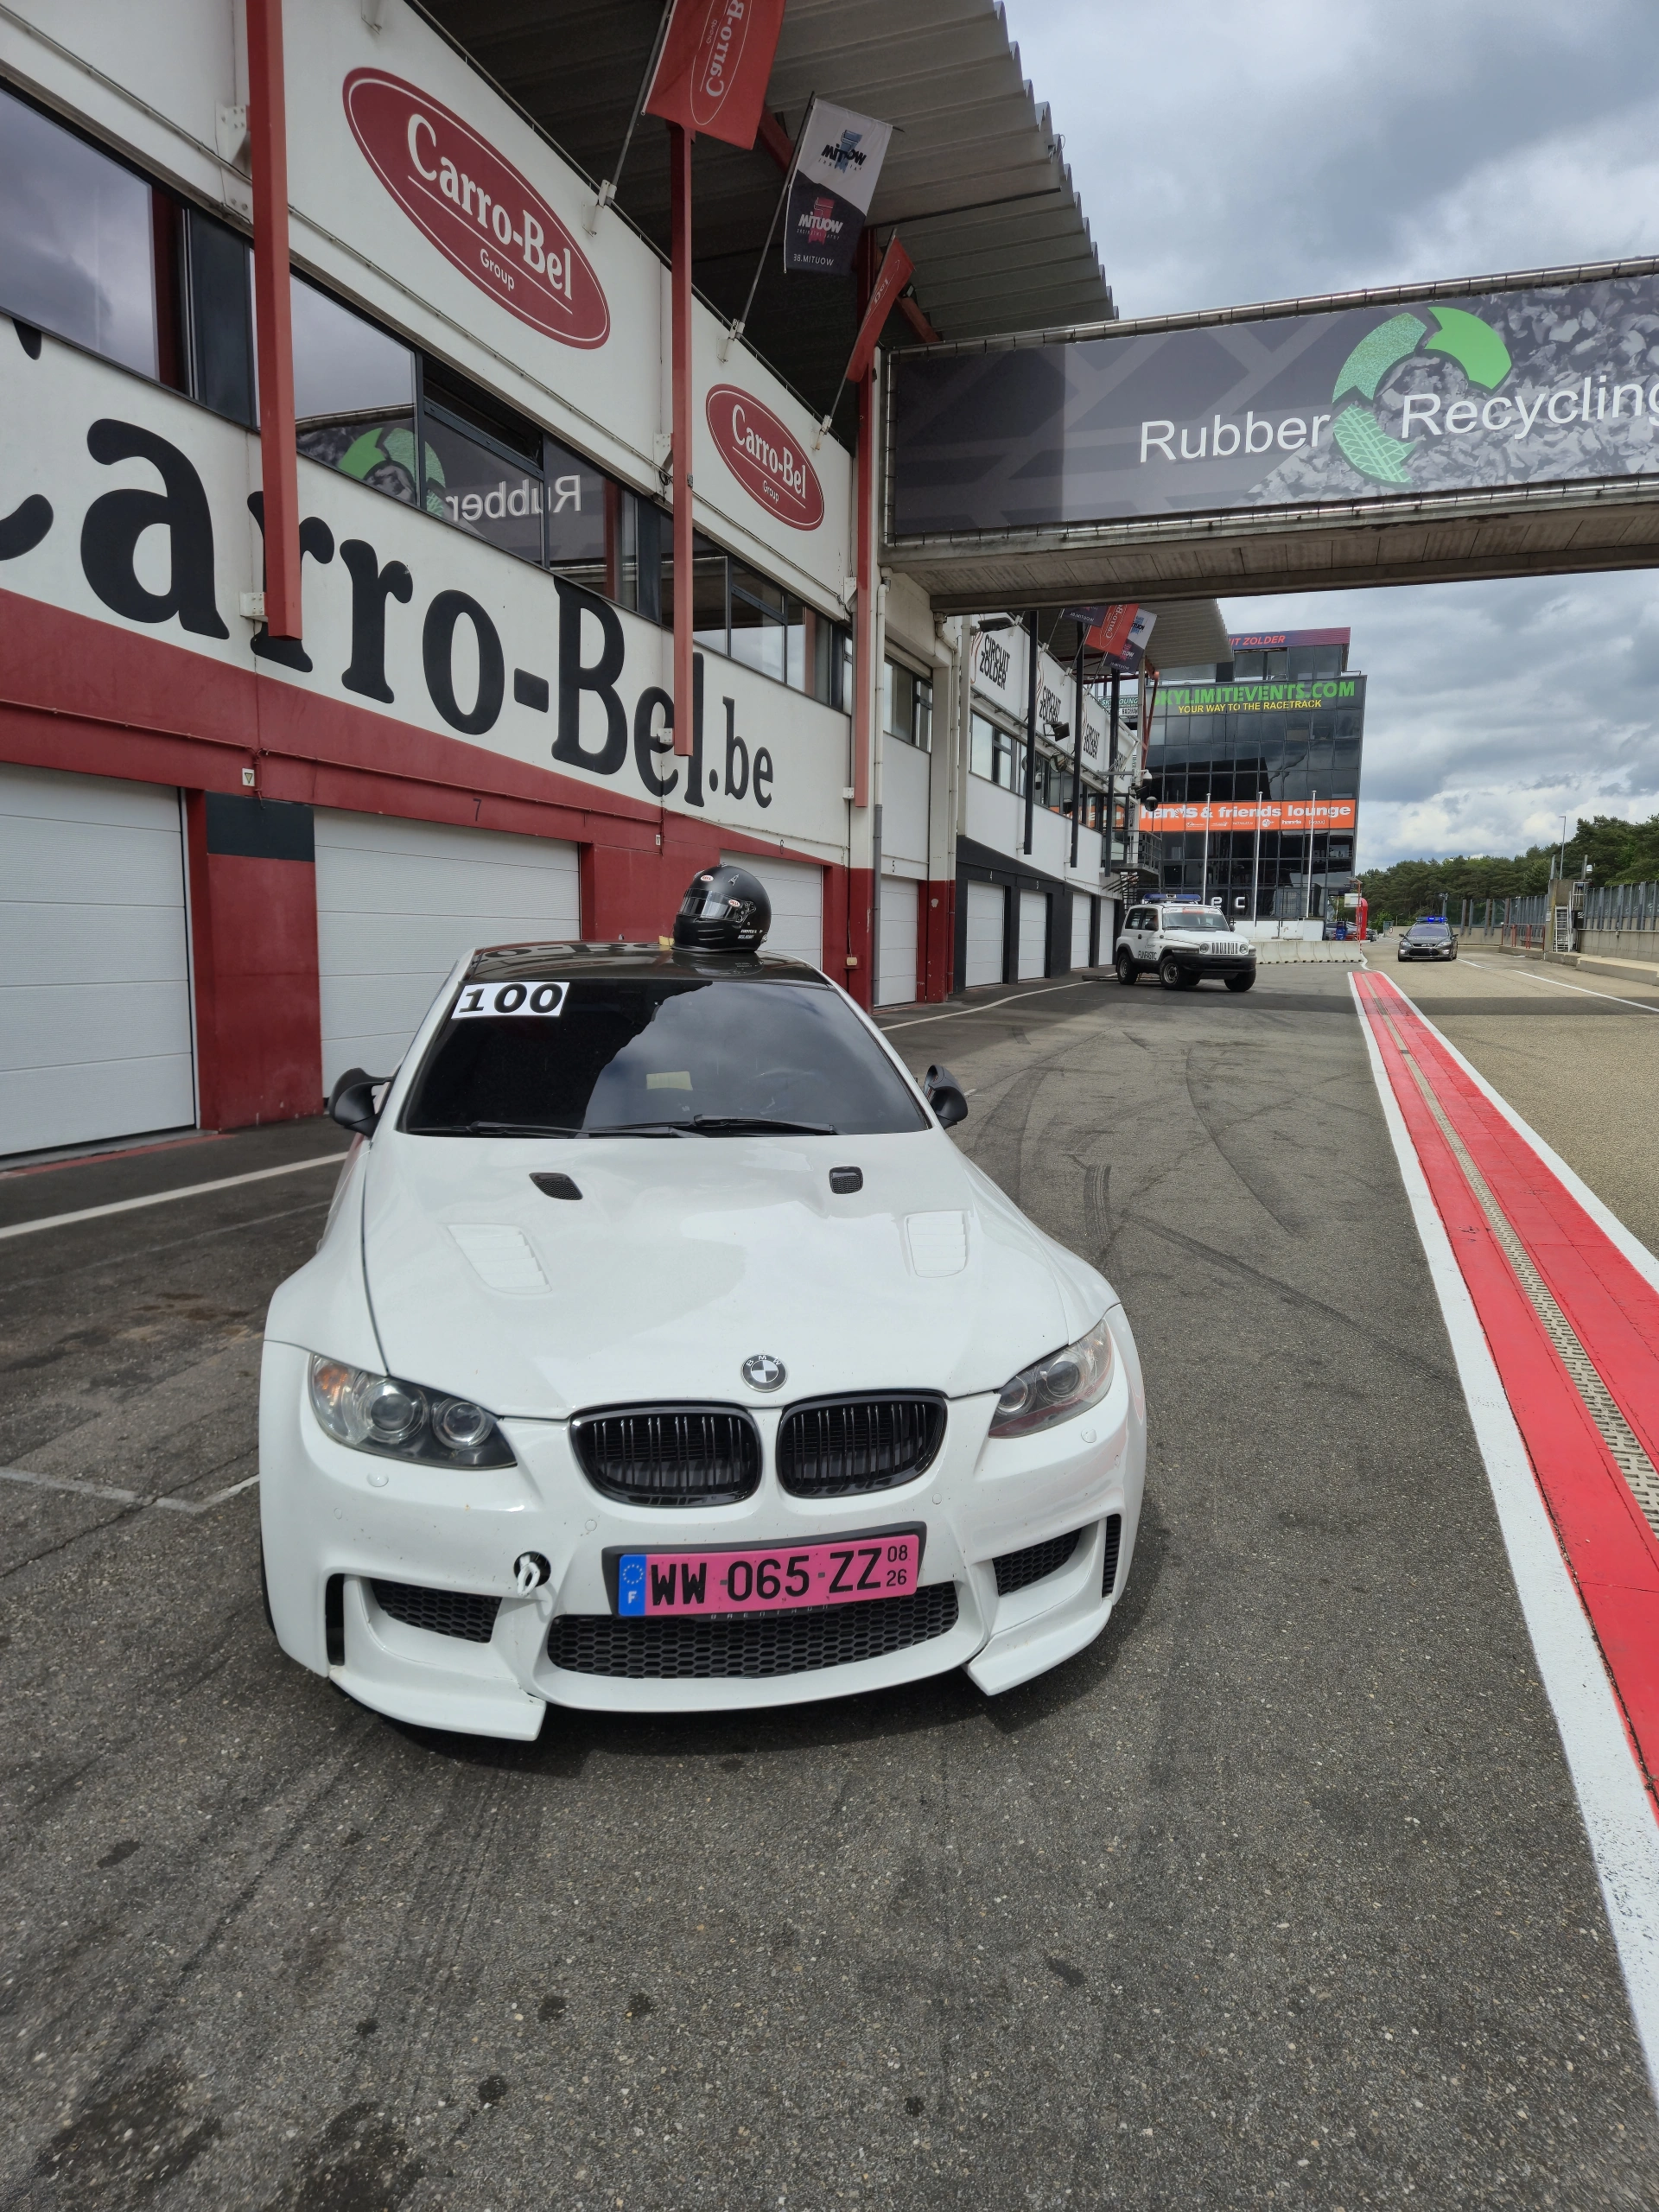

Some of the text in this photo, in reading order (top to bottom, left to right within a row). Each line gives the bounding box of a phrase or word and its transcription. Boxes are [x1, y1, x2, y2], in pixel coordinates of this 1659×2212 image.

[407, 113, 572, 301] Carro-Bel
[480, 248, 515, 291] Group
[1139, 408, 1331, 464] Rubber
[732, 404, 806, 499] Carro-Bel
[763, 480, 779, 504] Group
[1243, 635, 1286, 645] ZOLDER
[984, 633, 1011, 673] CIRCUIT
[979, 650, 1007, 690] ZOLDER
[1043, 685, 1062, 718] CIRCUIT
[1178, 699, 1322, 714] YOUR WAY TO THE RACETRACK
[473, 798, 481, 822] 7
[1200, 806, 1214, 818] &
[1218, 805, 1282, 818] friends
[1287, 804, 1351, 818] lounge
[458, 982, 563, 1014] 100
[746, 1355, 782, 1366] BMW
[887, 1545, 909, 1563] 08
[886, 1569, 908, 1587] 26
[627, 1592, 638, 1604] F
